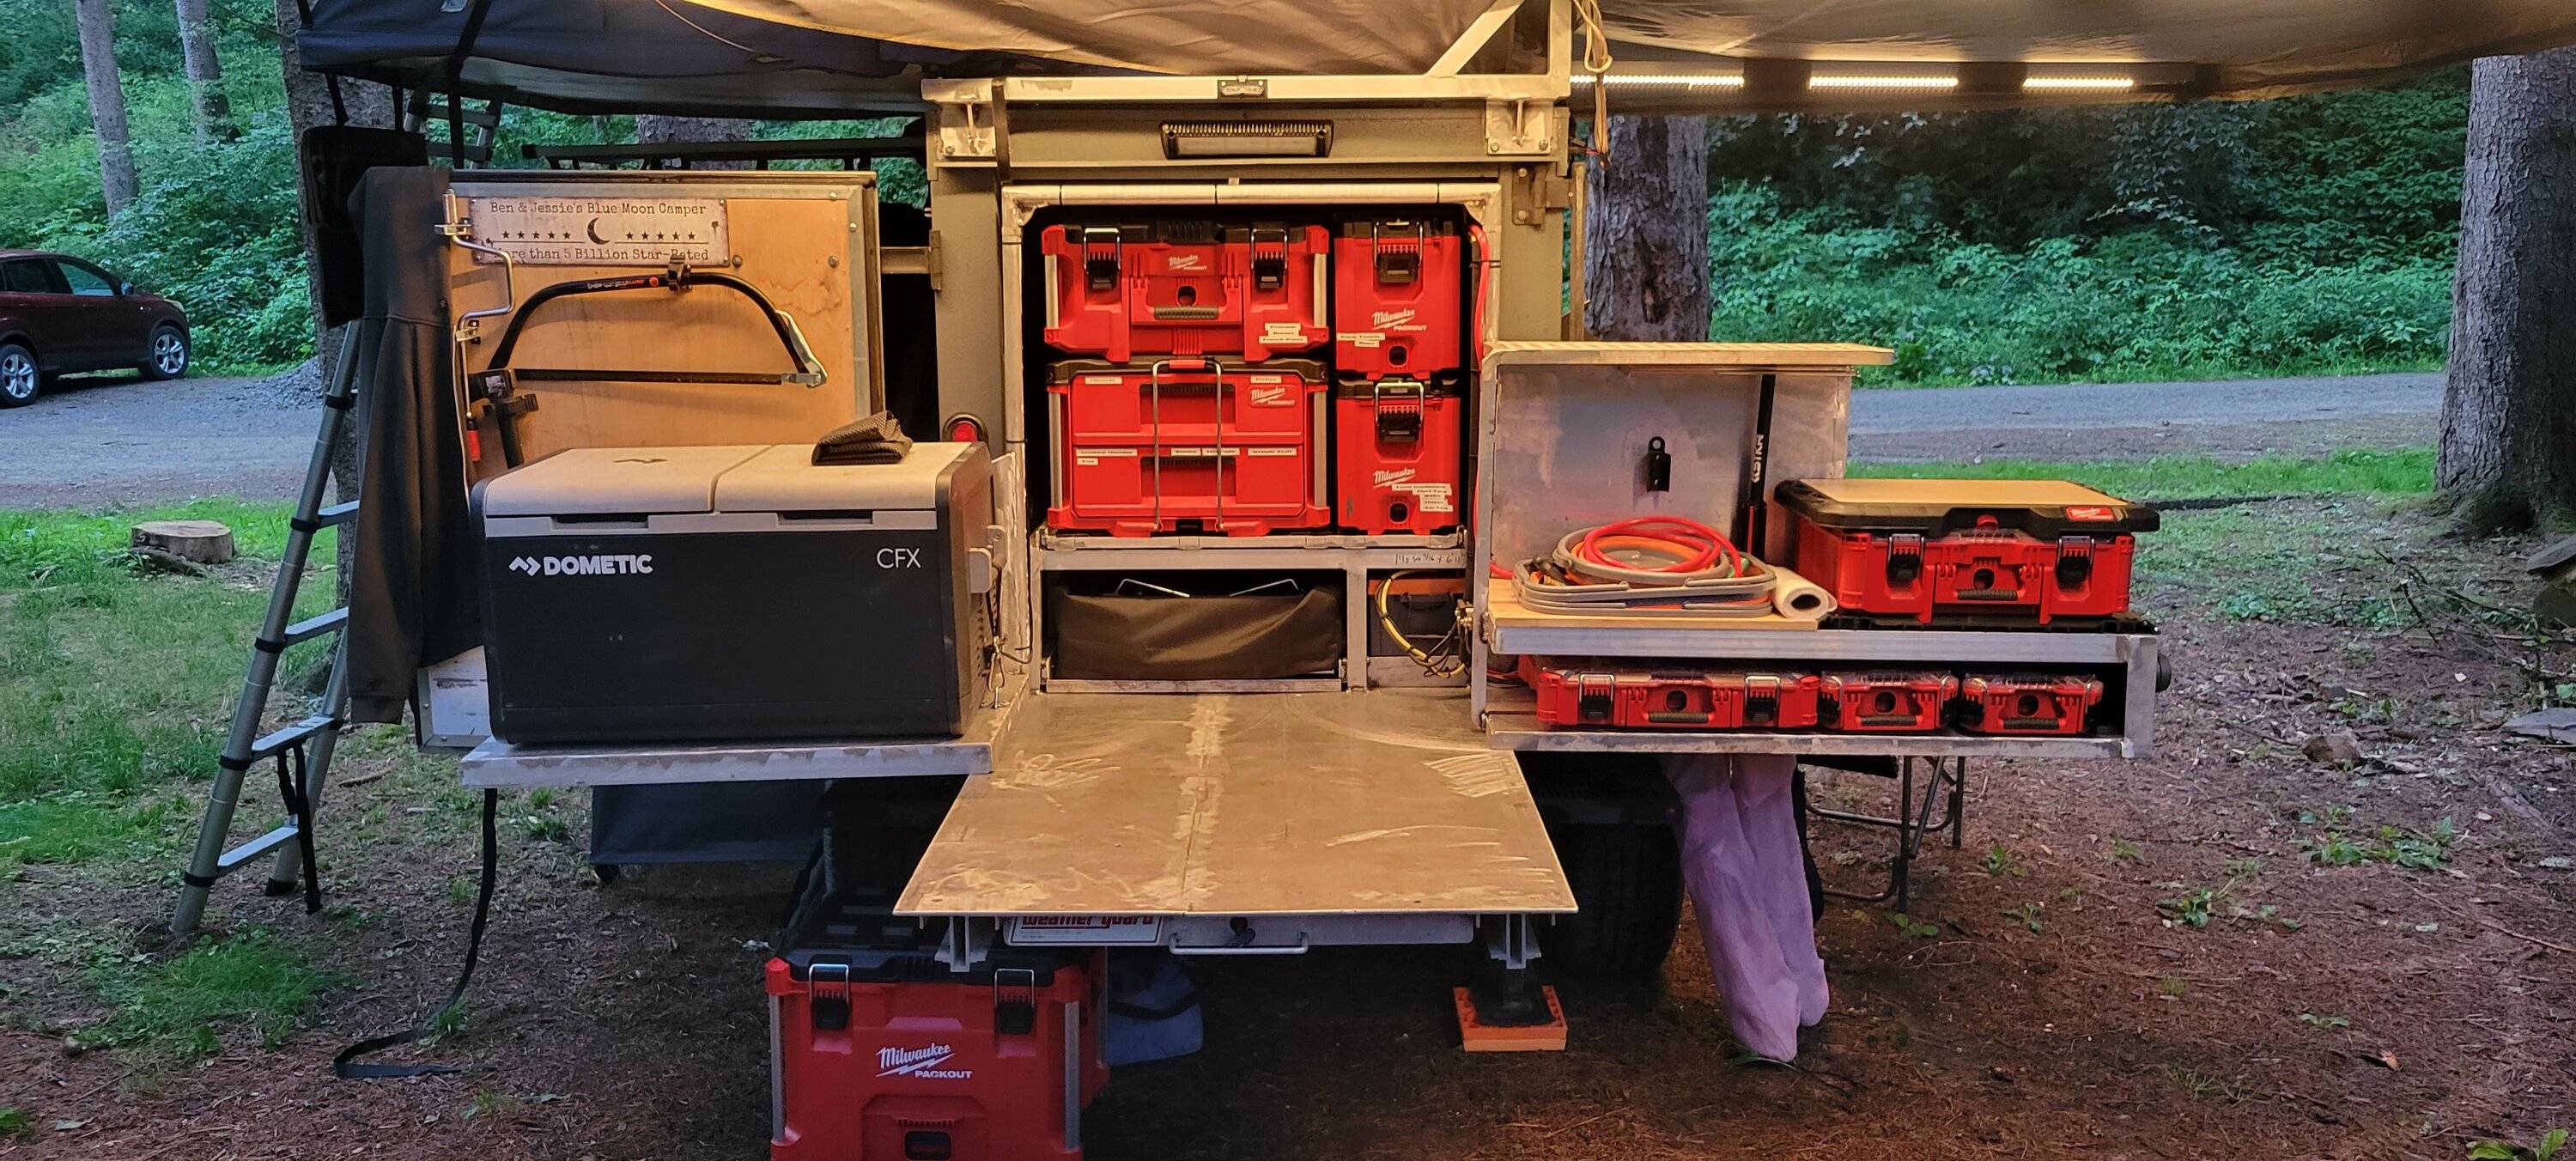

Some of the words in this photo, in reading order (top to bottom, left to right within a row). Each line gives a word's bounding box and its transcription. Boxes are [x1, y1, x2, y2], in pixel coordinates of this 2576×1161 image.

[490, 201, 513, 213] Ben
[518, 201, 527, 213] &
[531, 202, 583, 214] Jessie's
[587, 202, 618, 214] Blue
[622, 203, 655, 214] Moon
[659, 203, 707, 217] Camper
[529, 247, 560, 258] than
[564, 247, 572, 258] 5
[575, 248, 629, 259] Billion
[543, 554, 654, 576] DOMETIC
[876, 547, 921, 569] CFX
[876, 1042, 952, 1070] Milwaukee
[914, 1070, 973, 1079] PACKOUT
